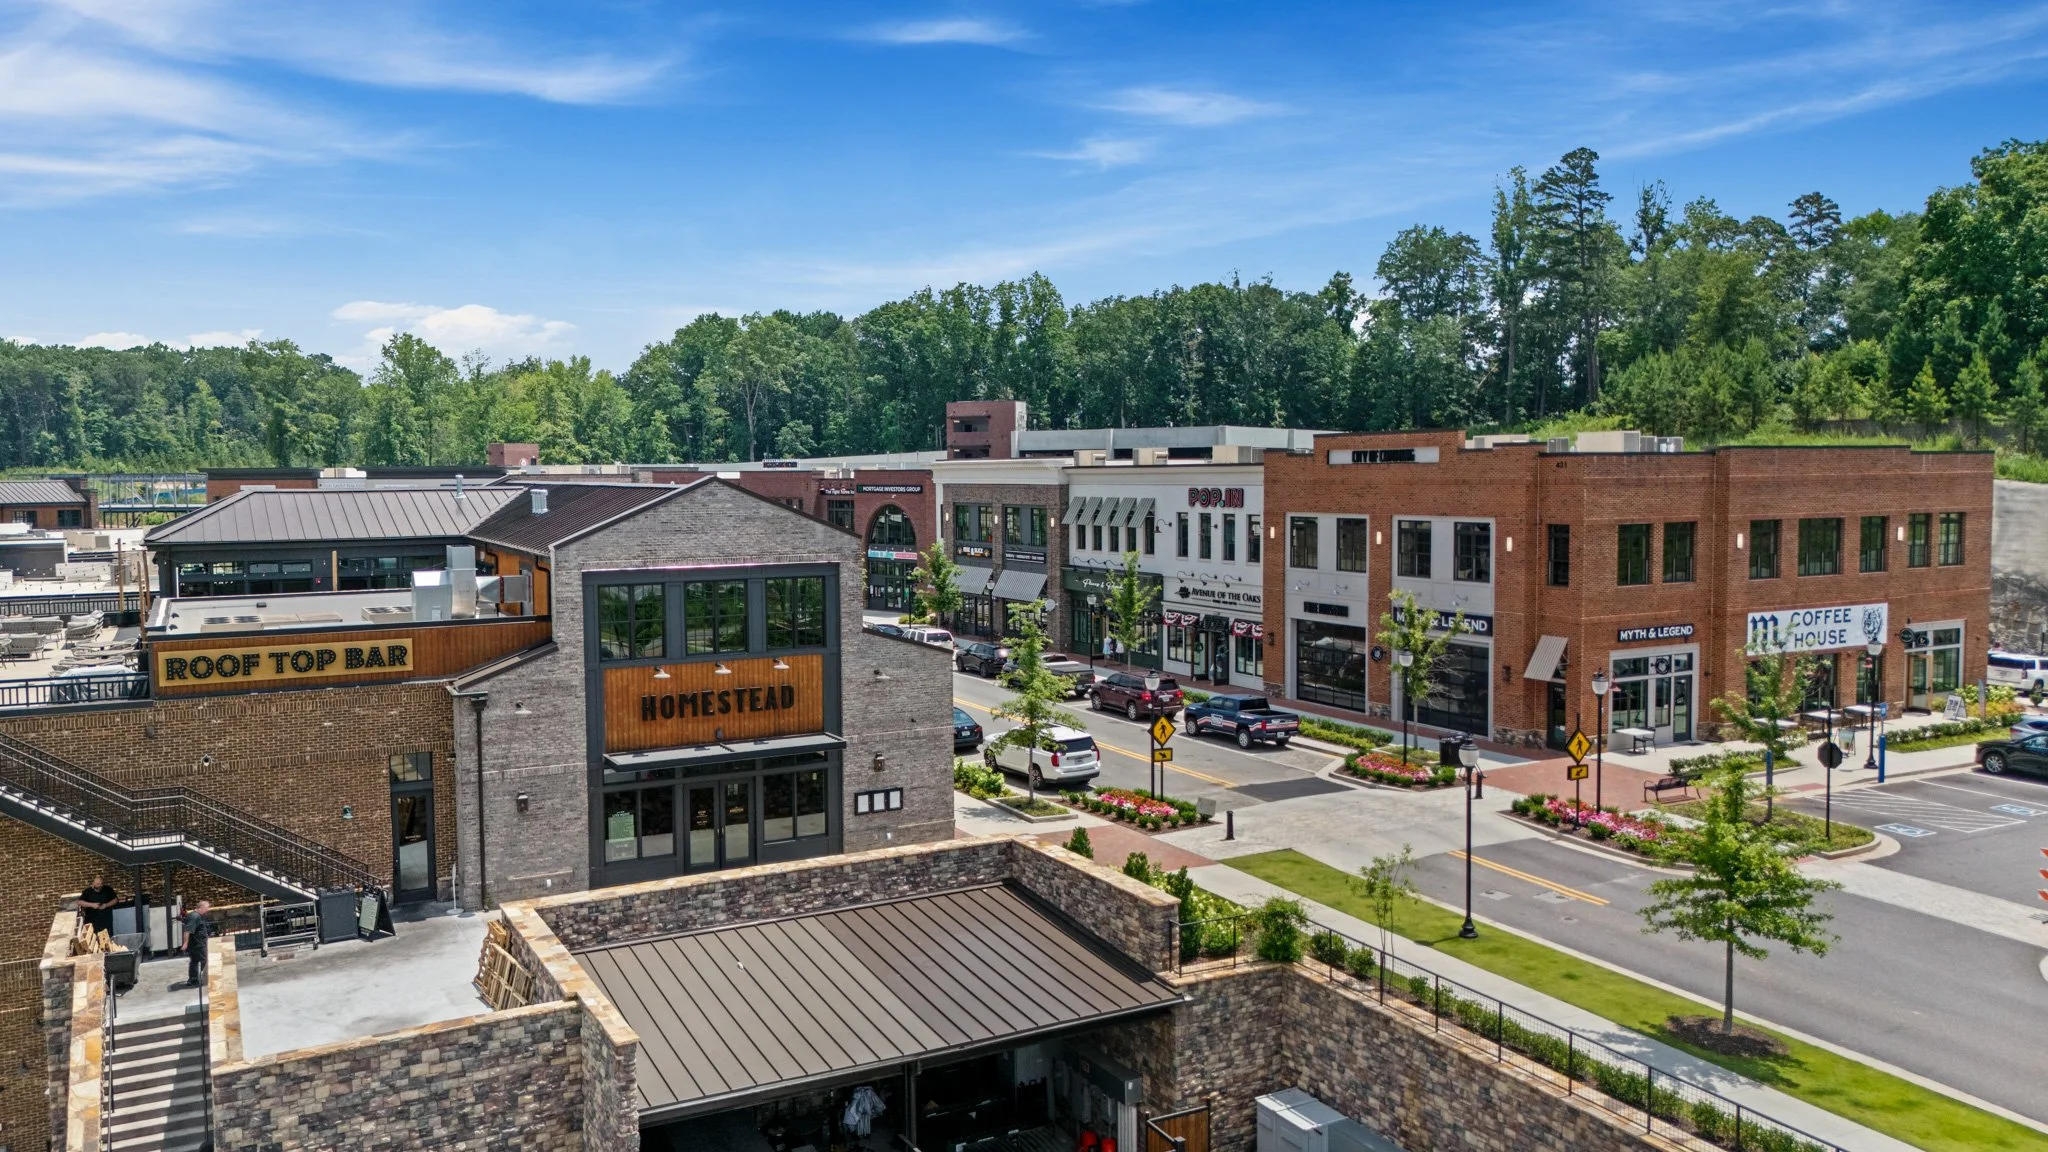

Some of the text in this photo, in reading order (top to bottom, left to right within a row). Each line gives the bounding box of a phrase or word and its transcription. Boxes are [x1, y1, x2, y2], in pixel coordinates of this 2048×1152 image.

[1188, 487, 1244, 508] POP.IN
[1192, 587, 1216, 598] AVENUE
[1217, 591, 1226, 599] OF
[1227, 592, 1241, 601] THE
[1242, 592, 1261, 603] OAKS
[1441, 616, 1488, 632] LEEND
[1791, 608, 1852, 627] COFFEE
[1620, 625, 1693, 641] MYTH & LEGEND
[1794, 629, 1847, 649] HOUSE
[165, 644, 408, 681] ROOF TOP BAR
[641, 684, 796, 722] HOMESTEAD
